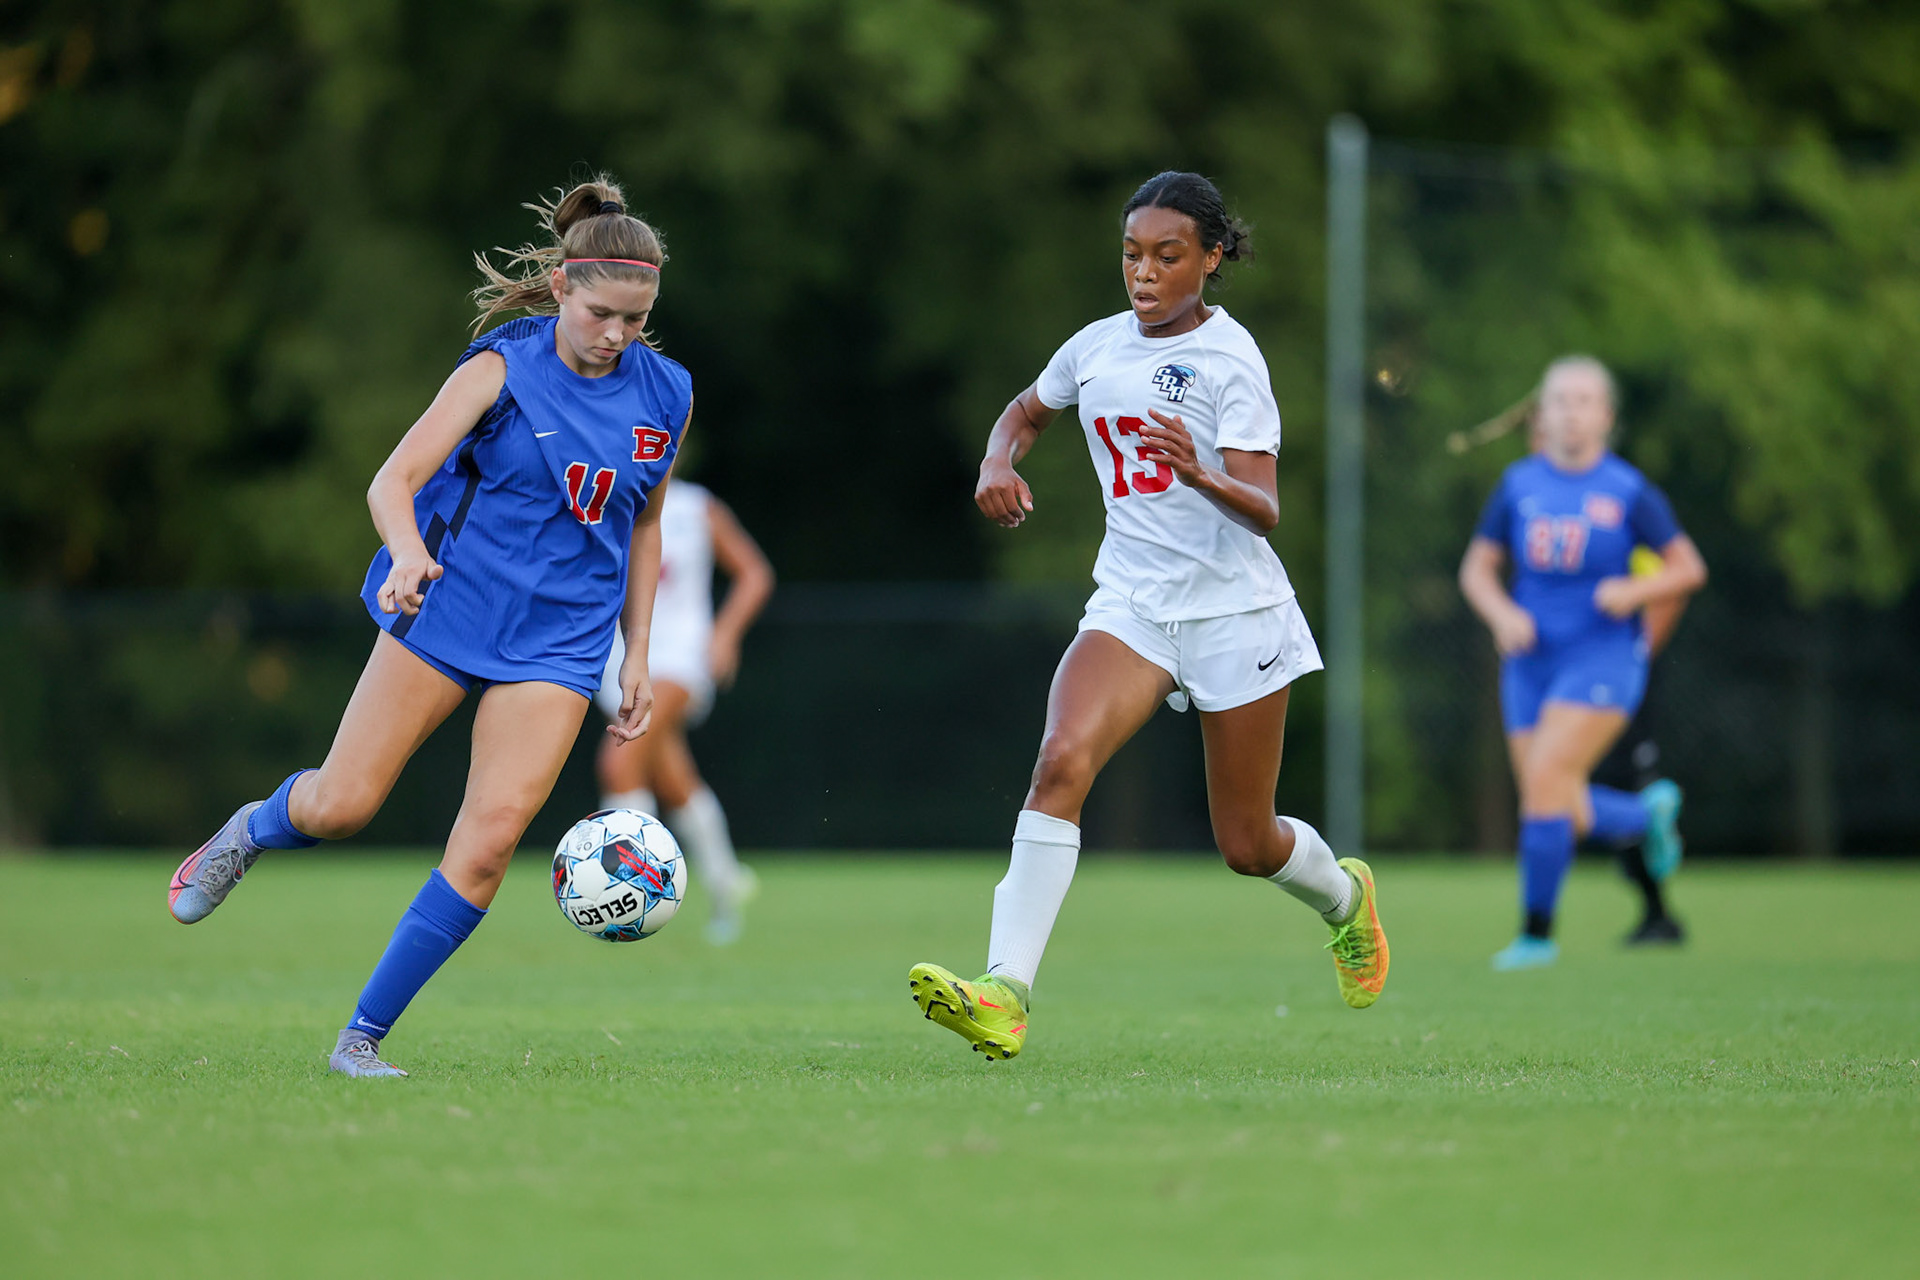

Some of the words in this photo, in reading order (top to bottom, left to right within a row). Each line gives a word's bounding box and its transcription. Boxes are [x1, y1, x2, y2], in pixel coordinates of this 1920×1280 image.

[632, 426, 671, 462] B
[1094, 416, 1173, 498] 13
[564, 461, 617, 525] 11
[572, 892, 638, 926] SELECT
